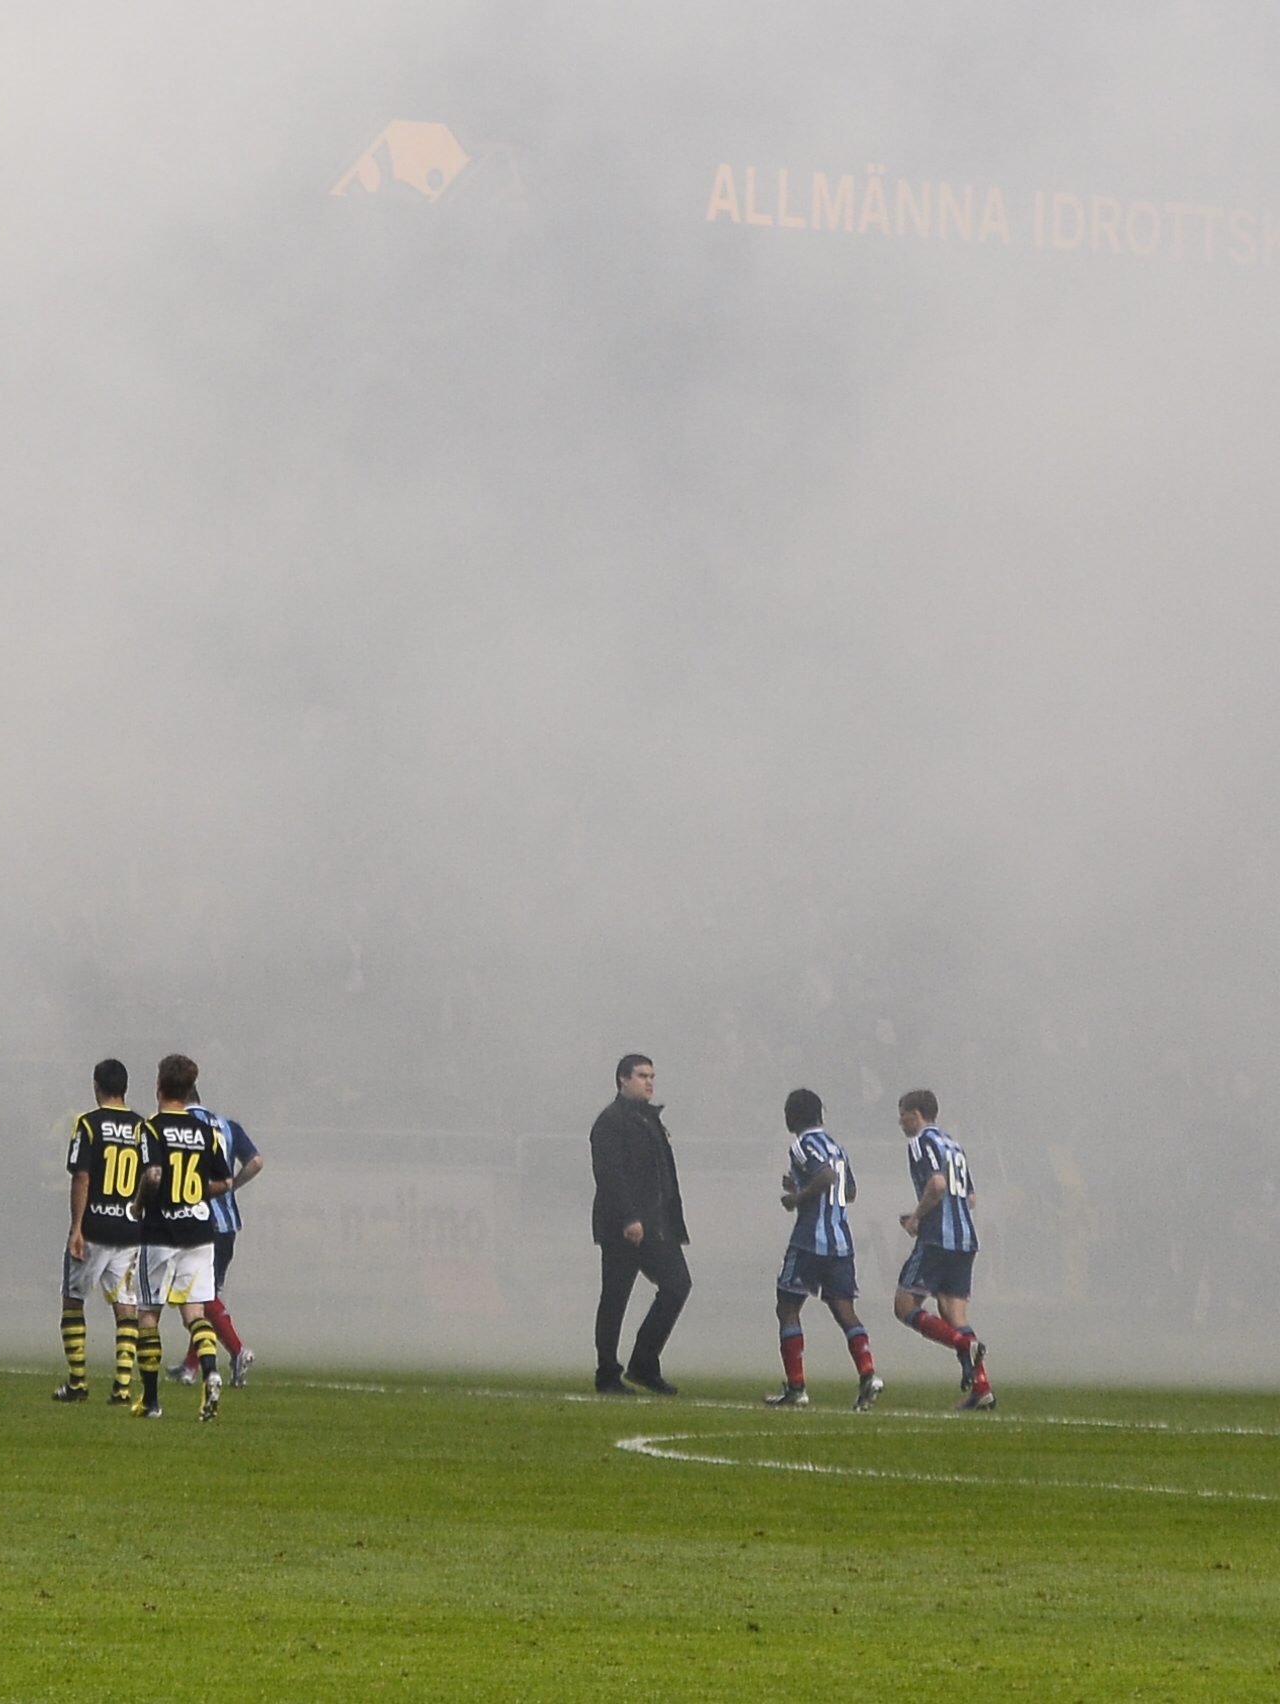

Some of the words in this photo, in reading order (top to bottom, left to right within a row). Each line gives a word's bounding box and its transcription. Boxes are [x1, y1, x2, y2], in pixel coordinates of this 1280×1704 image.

[706, 162, 1011, 245] ALLMÄNNA
[163, 1127, 205, 1145] SVEA
[103, 1145, 138, 1197] 10
[169, 1151, 203, 1205] 16
[945, 1150, 968, 1199] 13
